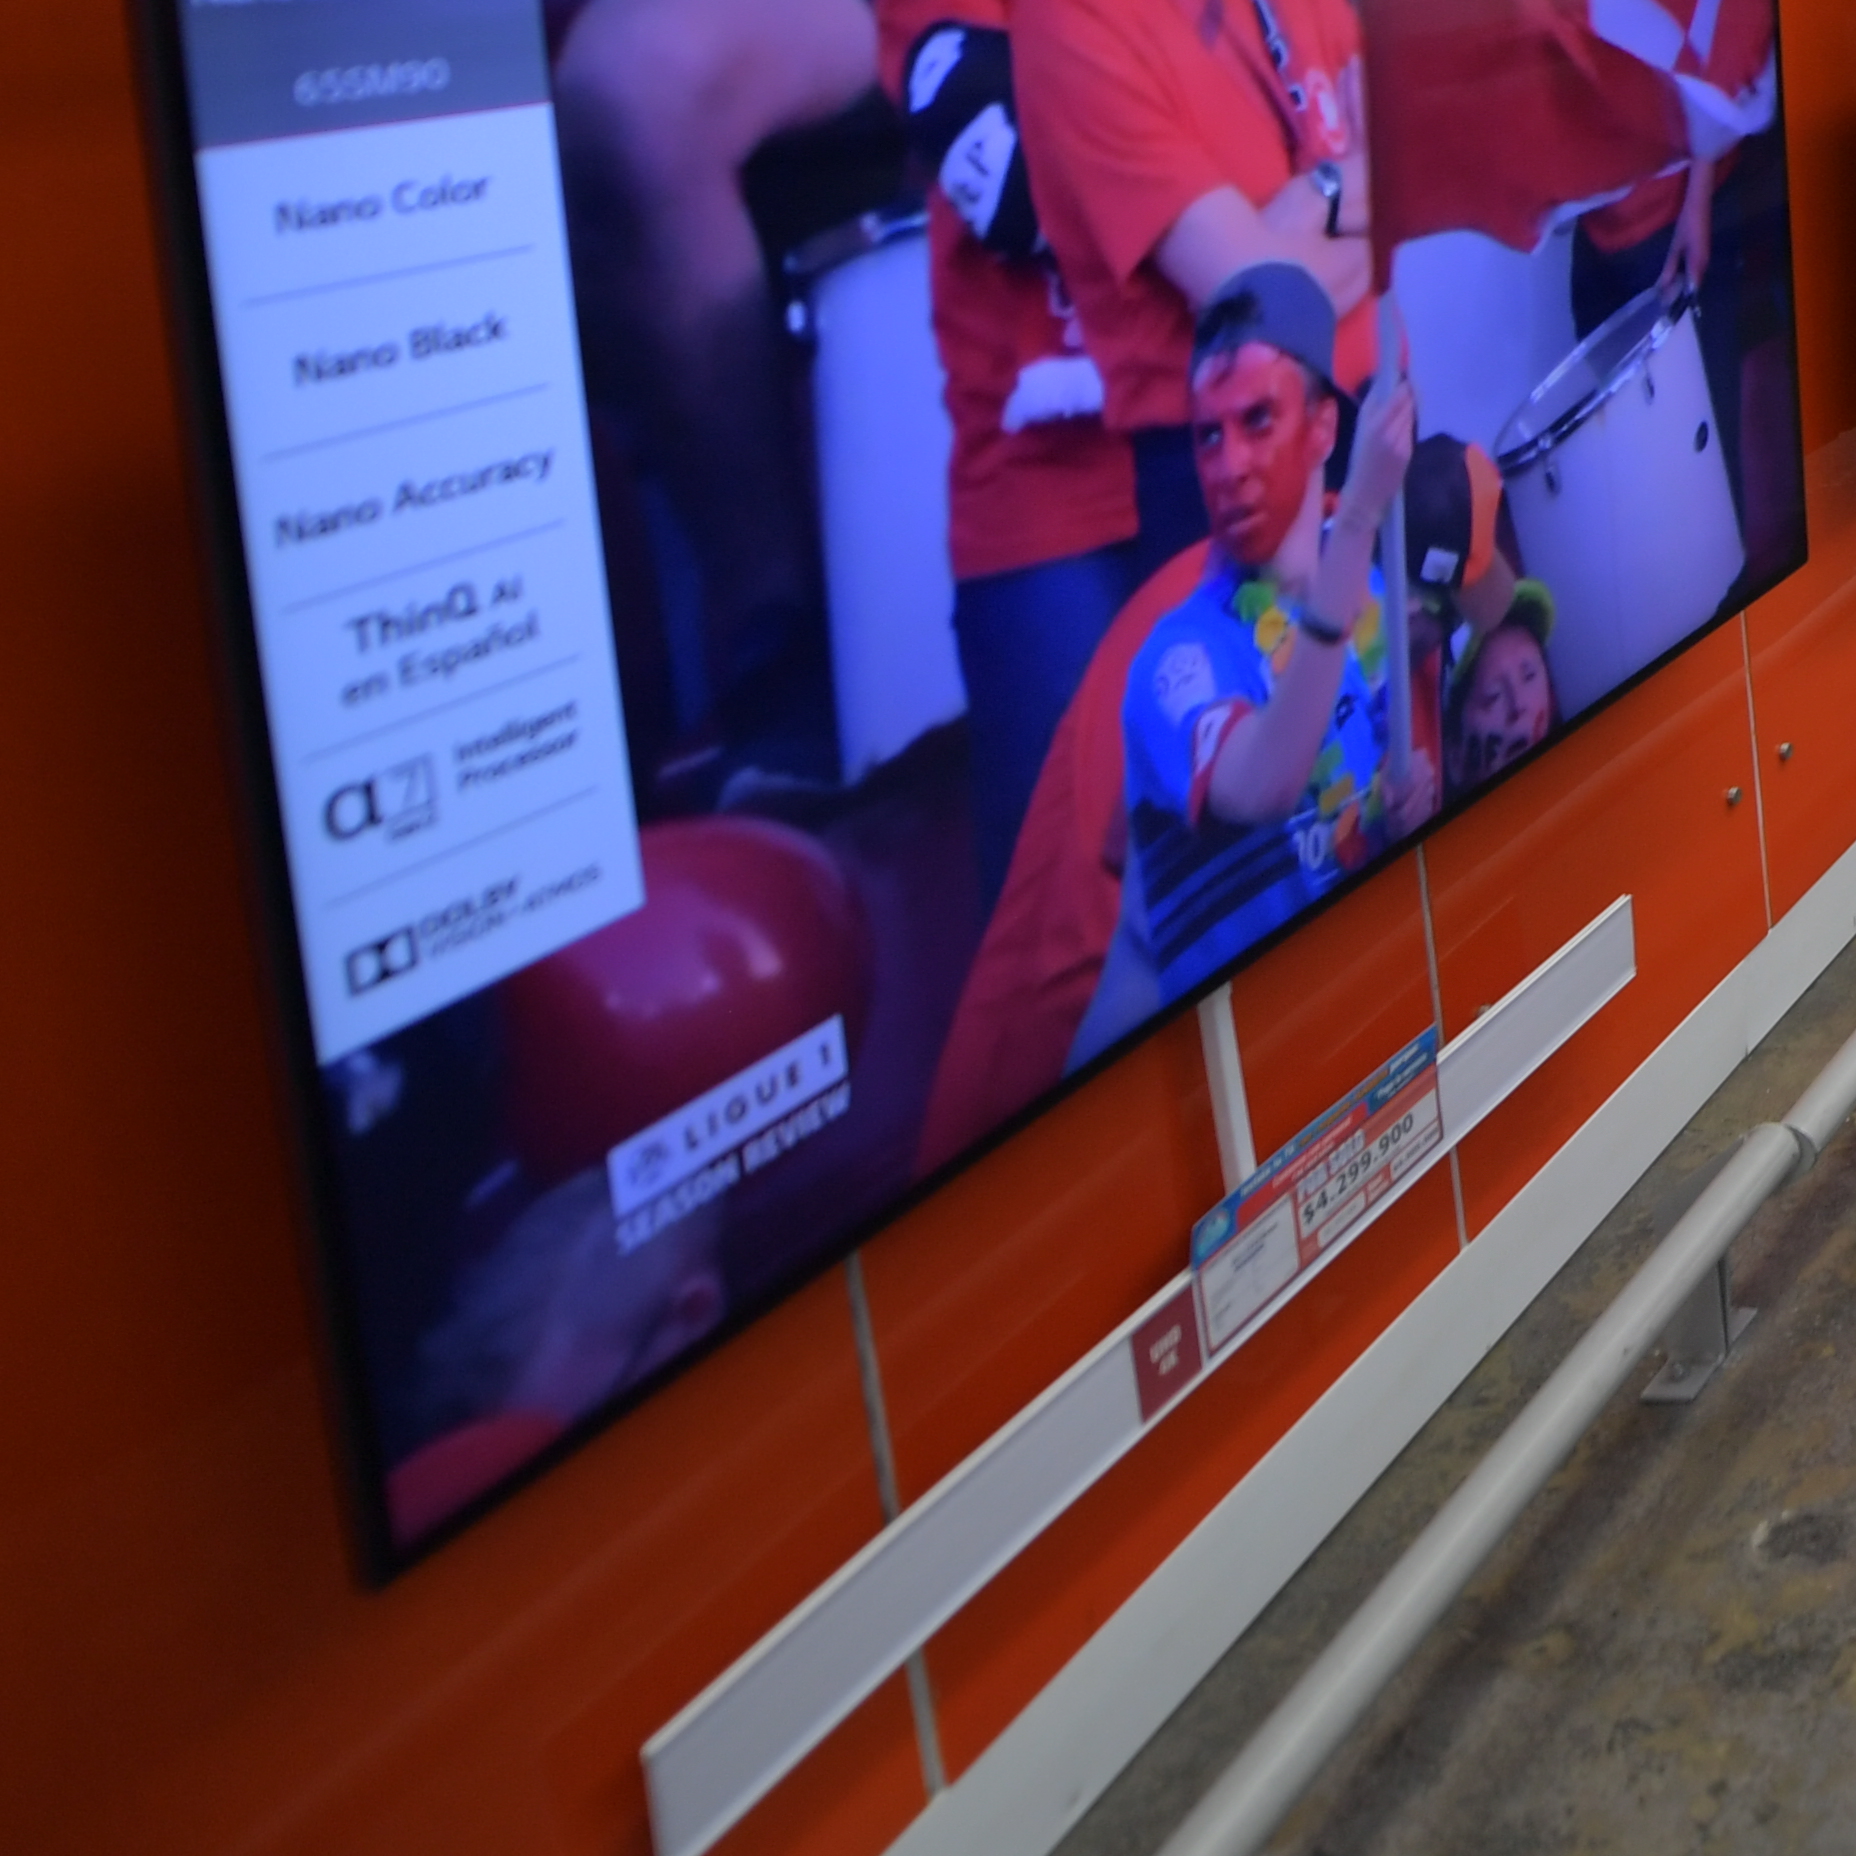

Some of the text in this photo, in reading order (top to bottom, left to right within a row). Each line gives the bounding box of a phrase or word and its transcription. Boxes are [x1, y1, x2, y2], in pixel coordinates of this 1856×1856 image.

[274, 173, 493, 236] Nano Color
[293, 308, 510, 387] Nano Black
[274, 448, 556, 549] Nano Accuracy
[340, 607, 542, 708] en Español
[344, 580, 481, 656] ThinQ
[683, 1067, 803, 1153] LIGUE
[615, 1081, 854, 1259] SEASON REVIEW
[1302, 1112, 1415, 1225] $4.299.900
